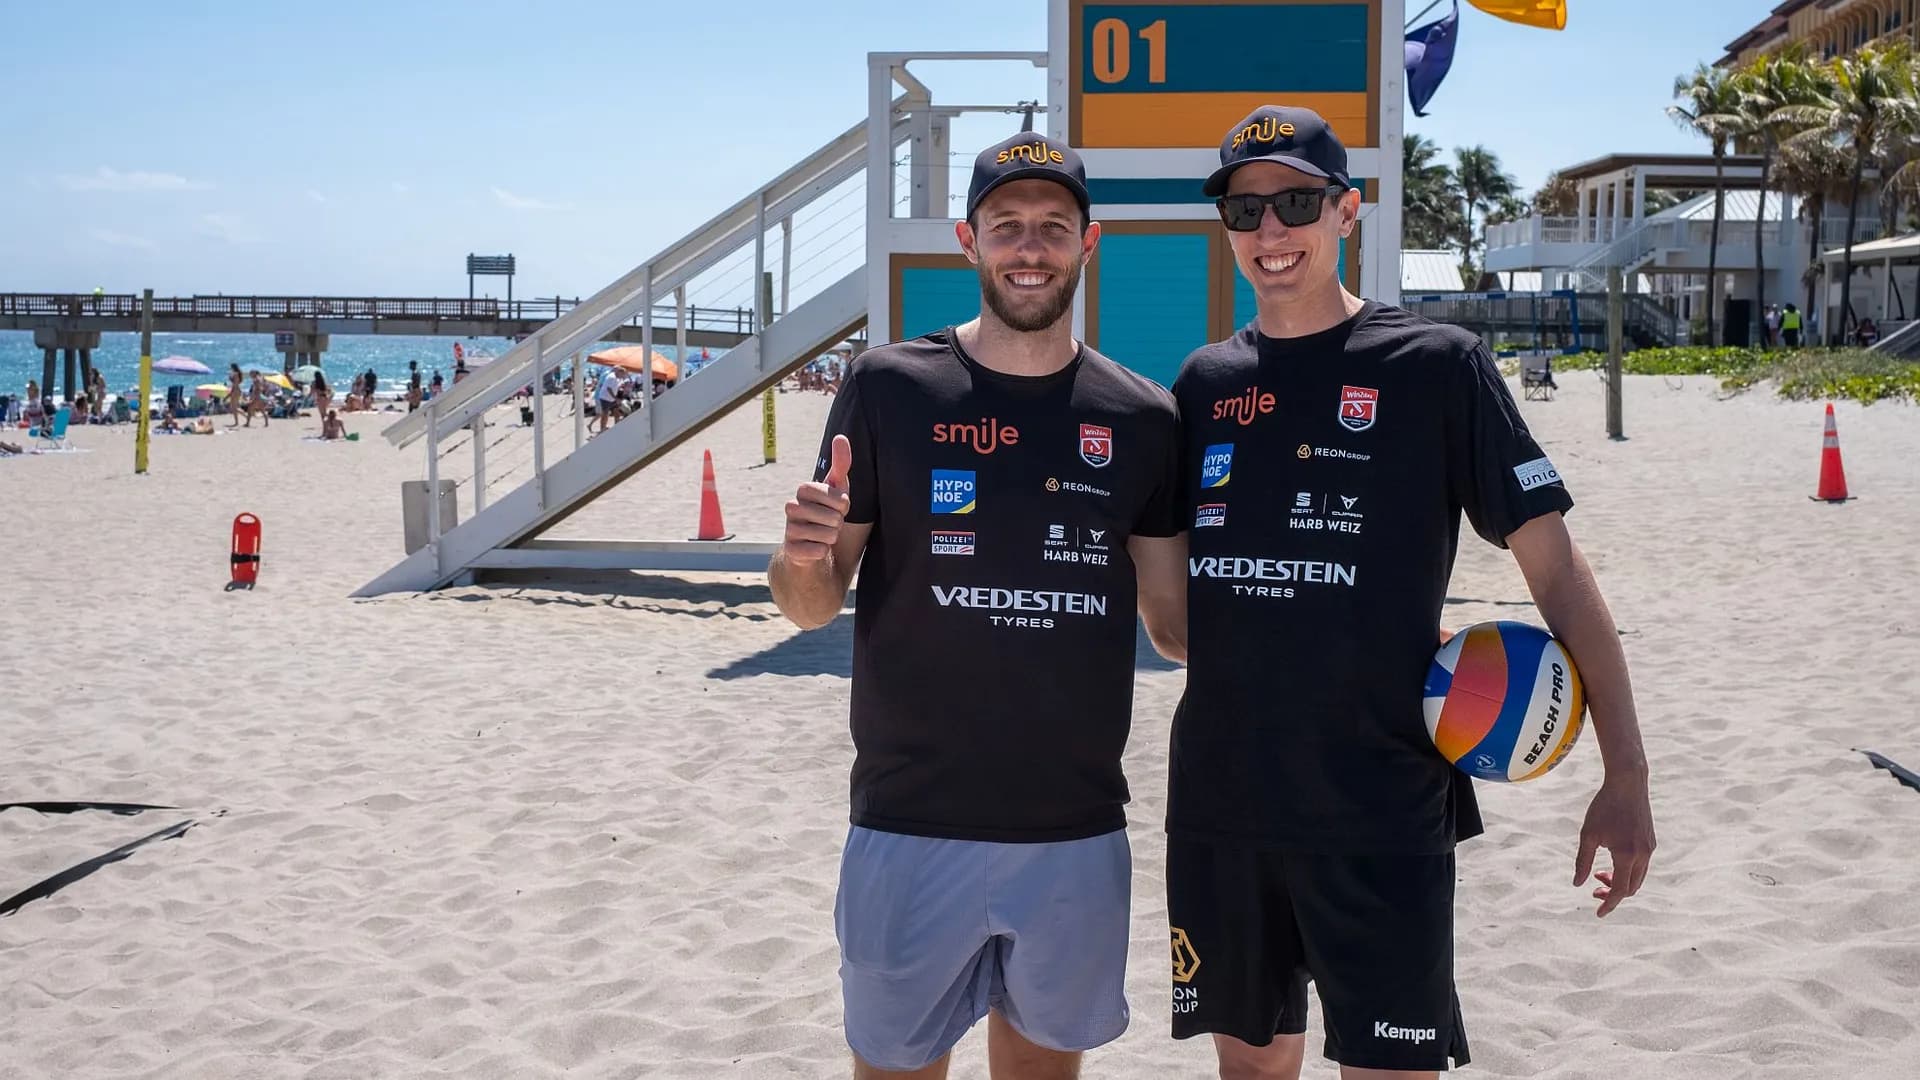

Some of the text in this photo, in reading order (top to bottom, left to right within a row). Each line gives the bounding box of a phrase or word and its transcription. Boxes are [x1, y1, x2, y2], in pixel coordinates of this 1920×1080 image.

[1092, 17, 1167, 84] 01
[1231, 116, 1296, 151] smile
[996, 140, 1064, 165] smile
[1213, 386, 1276, 426] smile
[933, 418, 1019, 454] smile
[1204, 454, 1231, 466] HYPO
[1203, 466, 1222, 478] NOE
[933, 480, 973, 491] HYPO
[933, 491, 963, 503] NOE
[1289, 518, 1362, 534] HARB WEIZ
[934, 535, 967, 544] POLIZEI
[933, 545, 958, 553] SPORT
[1044, 549, 1109, 566] HARB WEIZ
[1189, 556, 1357, 586] VREDESTEIN
[1231, 585, 1295, 598] TYRES
[931, 585, 1107, 616] VREDESTEIN
[989, 616, 1055, 628] TYRES
[1523, 662, 1564, 765] BEACH PRO
[1374, 1021, 1436, 1044] Kempa
